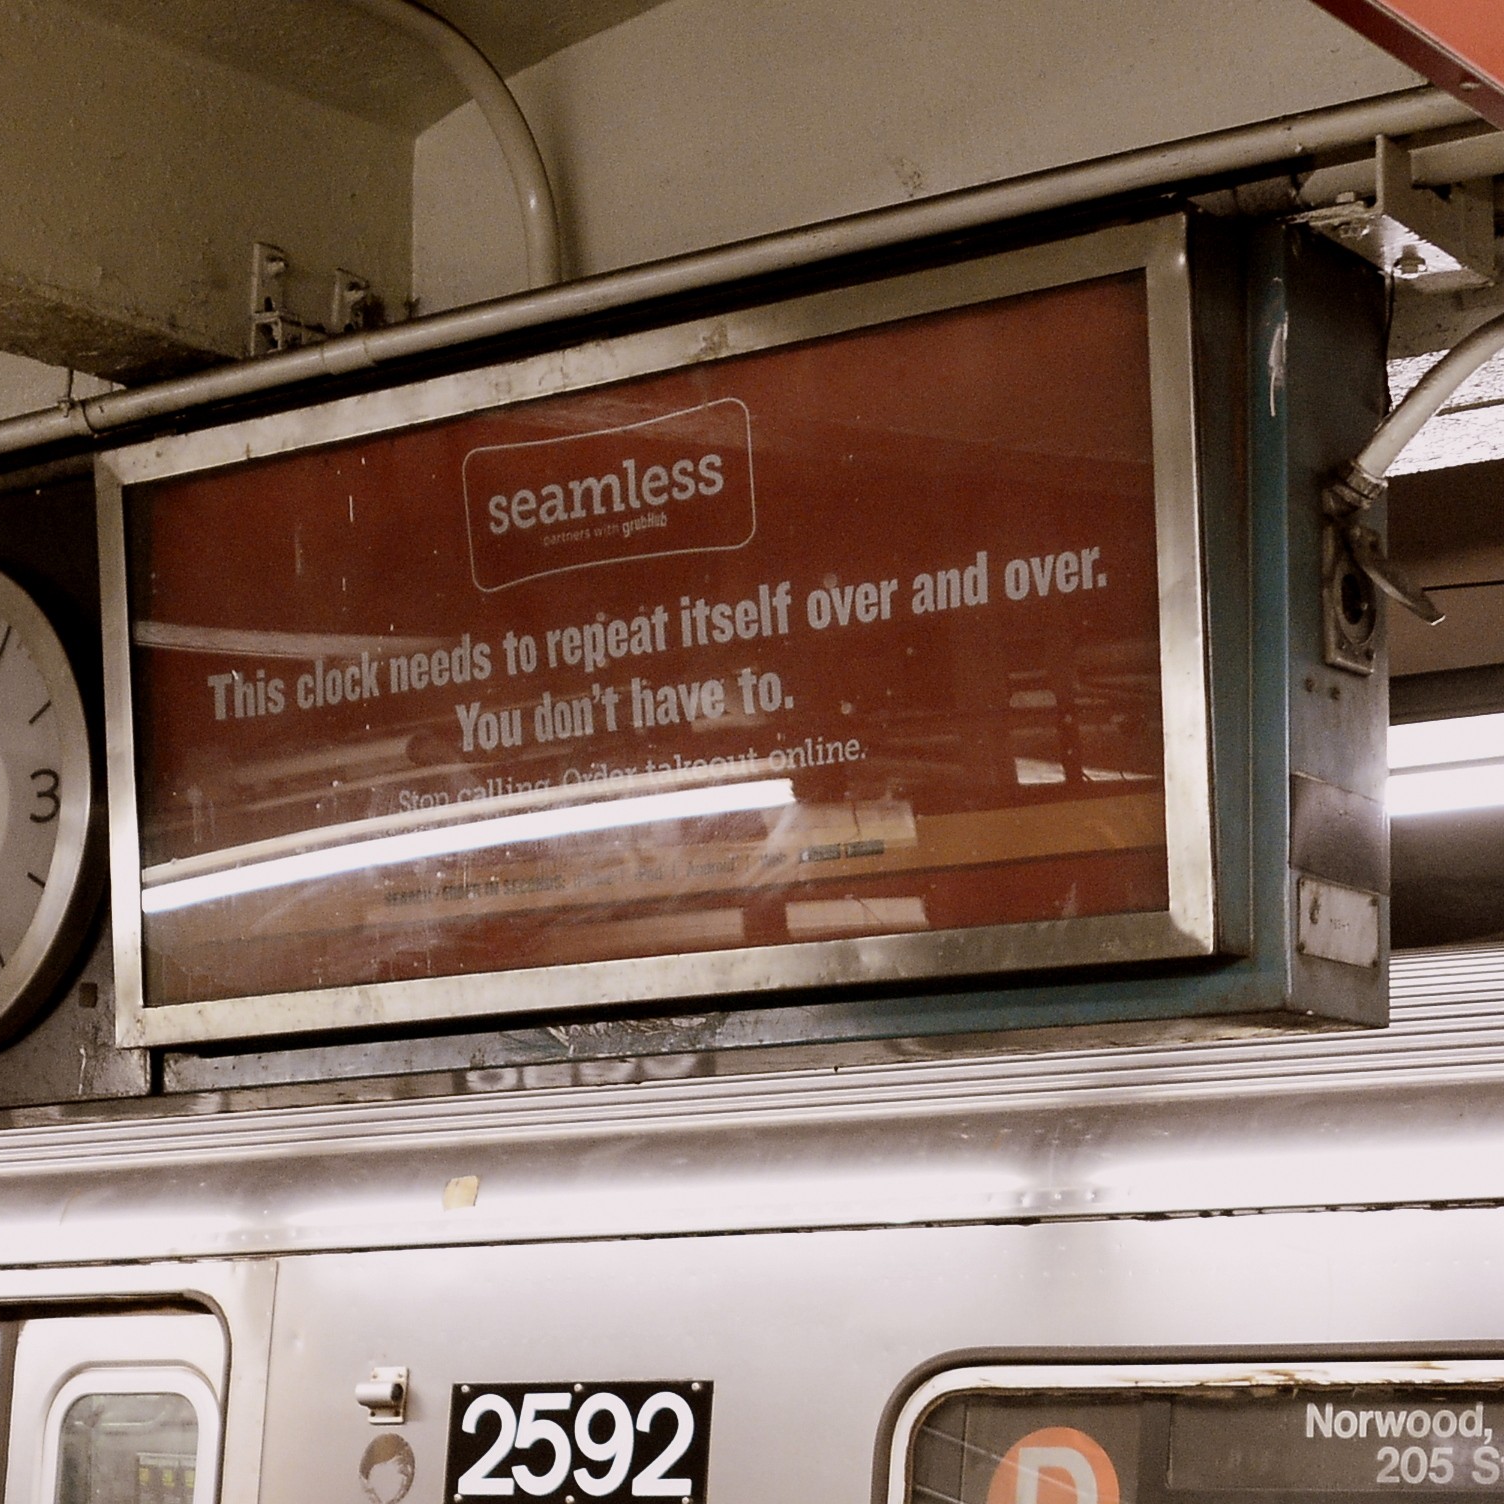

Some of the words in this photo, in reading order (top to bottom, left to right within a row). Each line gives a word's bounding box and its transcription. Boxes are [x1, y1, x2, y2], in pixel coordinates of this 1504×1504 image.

[489, 452, 724, 534] seamless
[543, 528, 591, 547] partners
[208, 670, 285, 721] This
[295, 650, 380, 710] clock
[389, 633, 492, 695] needs
[504, 628, 537, 677] to
[547, 606, 669, 676] repeat
[680, 581, 792, 648] itself
[806, 577, 899, 631] over
[911, 551, 988, 614] and
[1004, 546, 1108, 601] over.
[455, 702, 523, 754] You
[535, 684, 620, 743] don't
[631, 676, 725, 731] have
[741, 668, 795, 715] to.
[30, 768, 61, 824] 3
[398, 788, 450, 817] Stop
[644, 748, 758, 781] takeout
[768, 738, 867, 771] online.
[457, 1391, 694, 1498] 2592
[1306, 1401, 1493, 1445] Norwood,
[1376, 1445, 1455, 1484] 205
